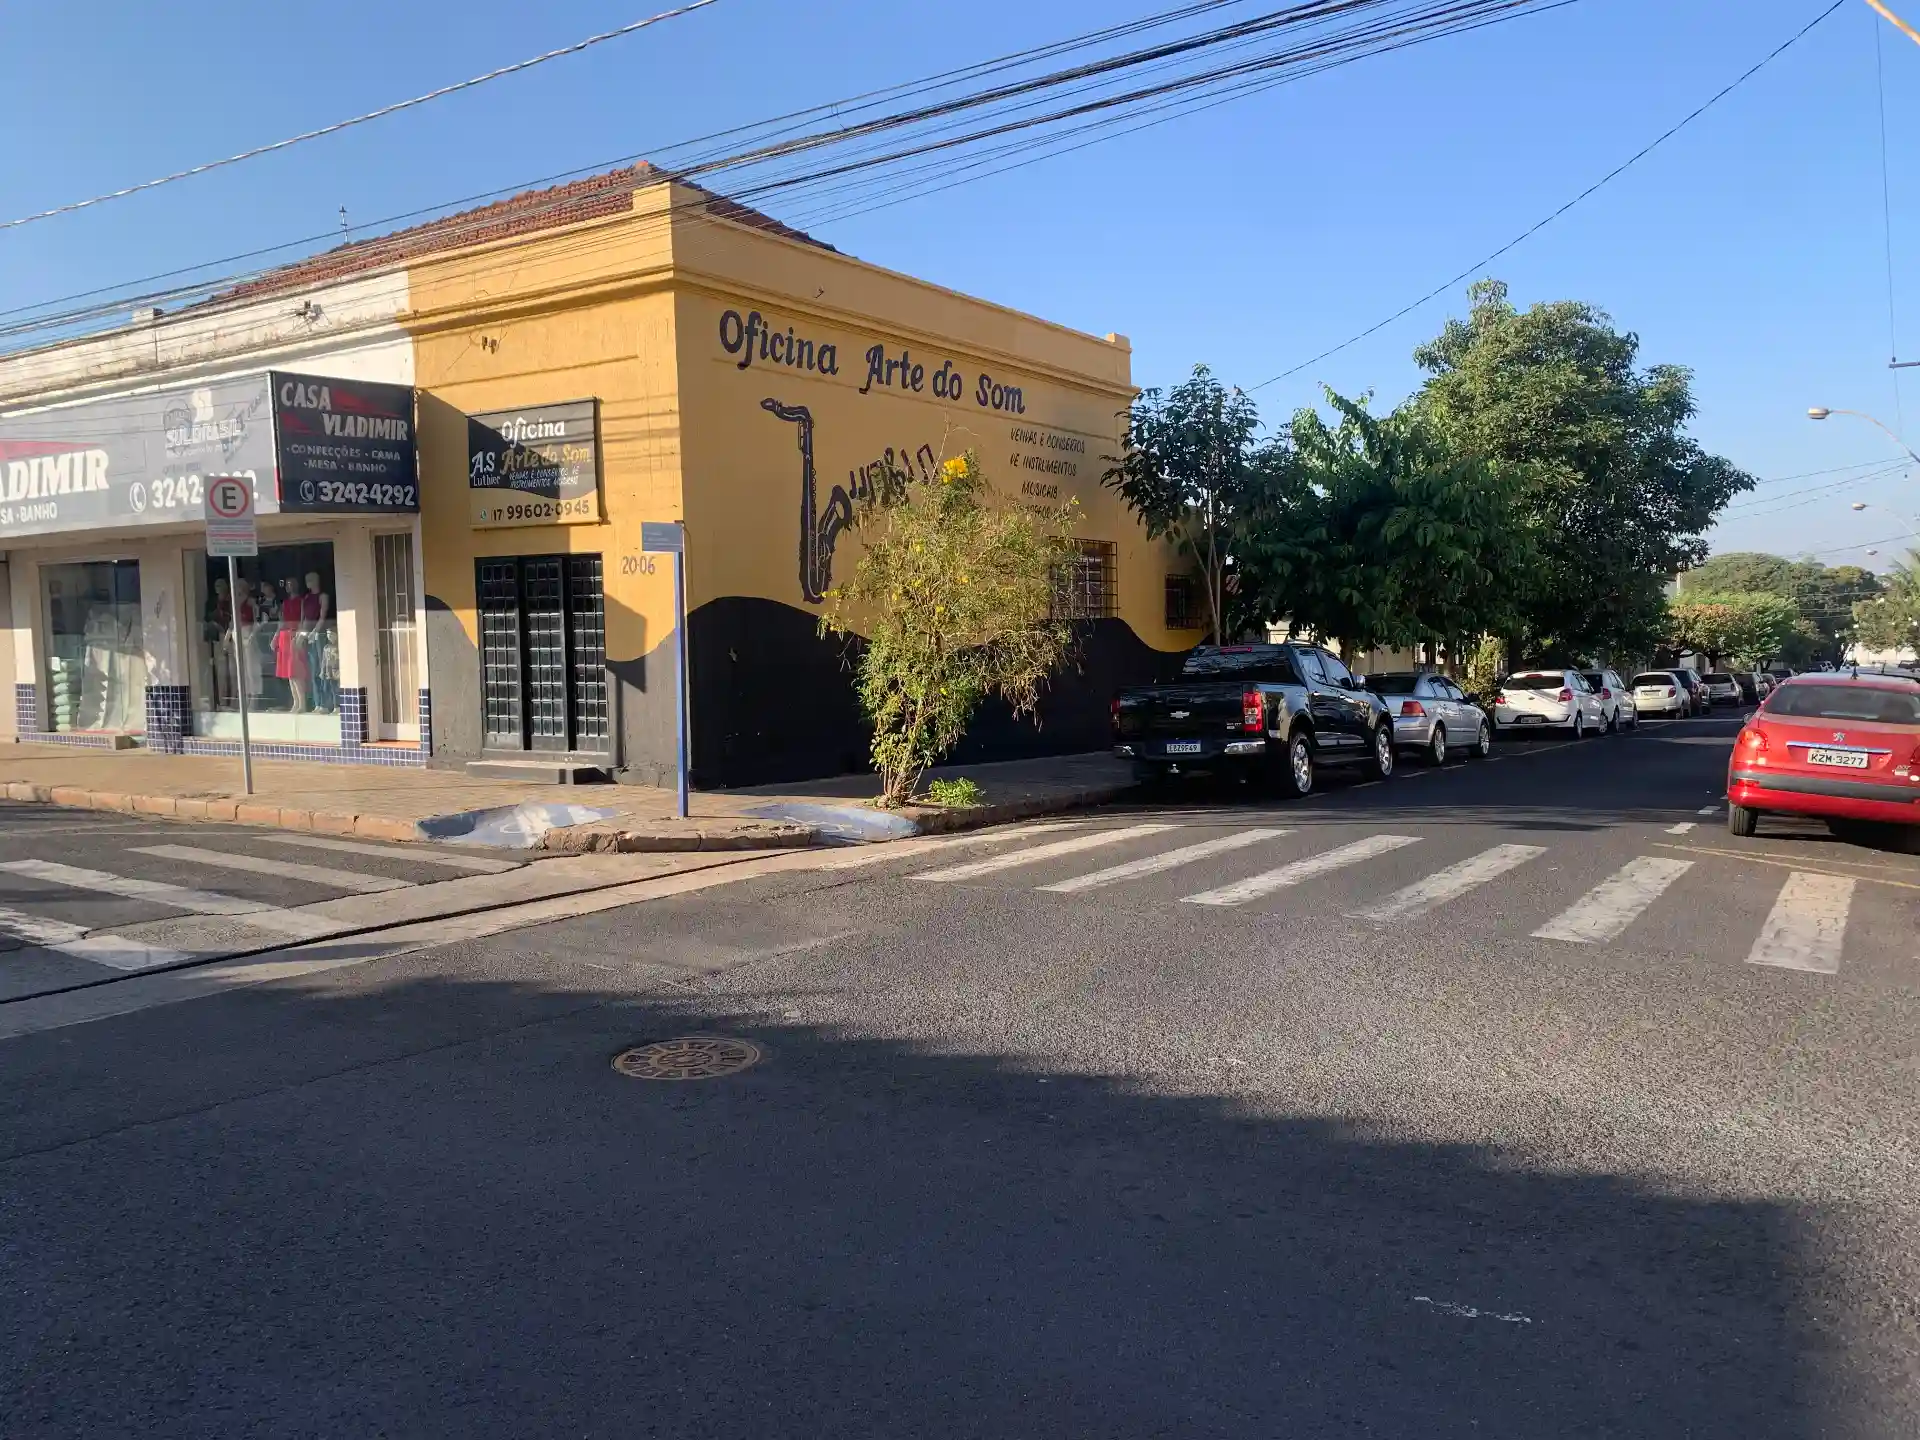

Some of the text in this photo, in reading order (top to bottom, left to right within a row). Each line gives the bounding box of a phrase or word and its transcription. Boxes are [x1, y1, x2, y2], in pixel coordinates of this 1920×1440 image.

[719, 309, 1026, 414] Oficina Arte do Som
[281, 382, 332, 411] CASA
[321, 412, 409, 441] VLADIMIR
[501, 417, 565, 448] Oficina
[1046, 432, 1085, 454] CONSERTOS
[308, 459, 387, 473] MESA BANHO
[371, 450, 401, 460] CAMA
[500, 445, 539, 475] Arte
[1022, 455, 1077, 477] INSTRUMENTOS
[152, 469, 259, 508] 3242-
[473, 475, 501, 487] Luthier
[222, 486, 237, 509] E
[20, 501, 58, 523] BANHO
